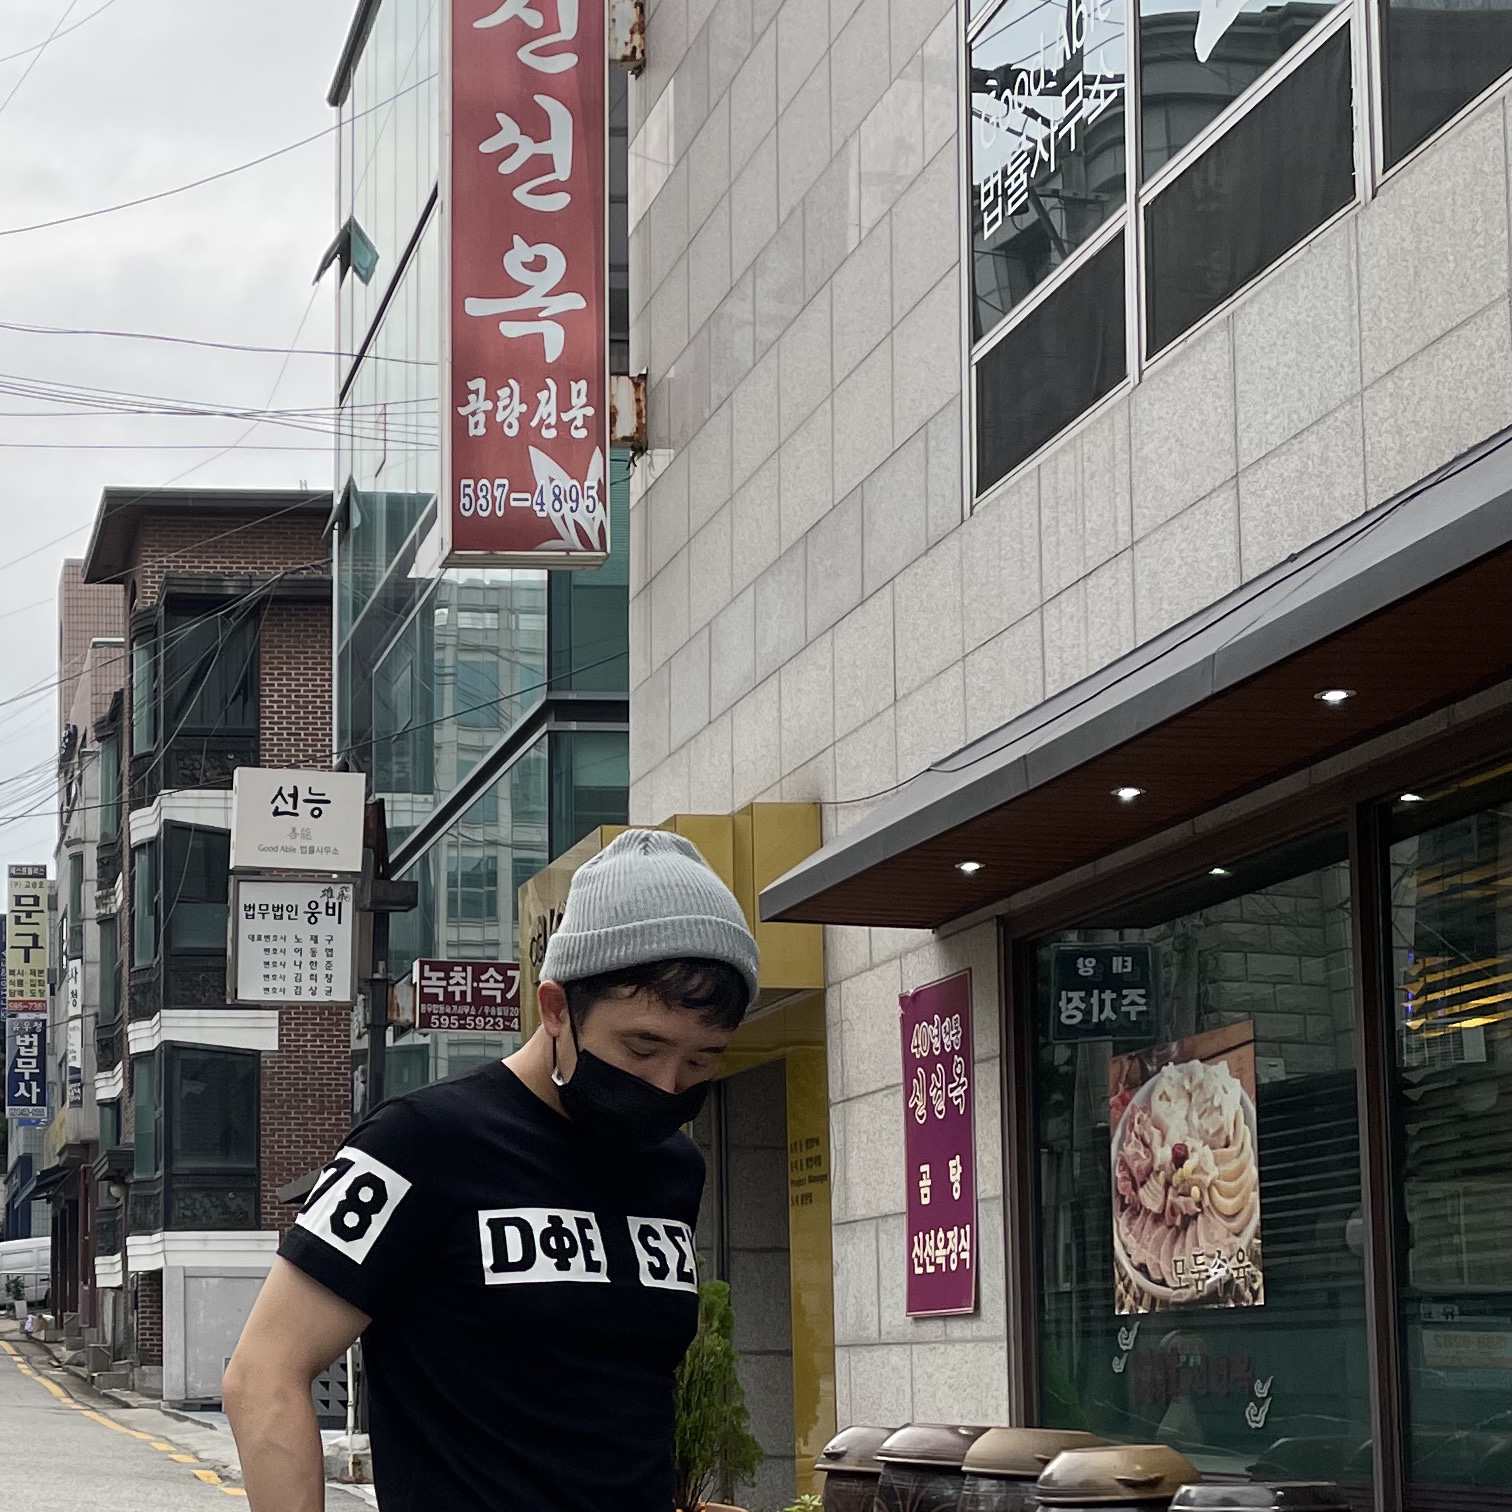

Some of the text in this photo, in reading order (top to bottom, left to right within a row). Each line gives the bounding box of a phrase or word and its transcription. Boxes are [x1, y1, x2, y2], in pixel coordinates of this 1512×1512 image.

[459, 478, 598, 519] 537-4895
[270, 785, 332, 819] 선능
[257, 843, 279, 853] Good
[9, 893, 45, 964] 문구
[243, 899, 343, 925] 법무법인 웅비
[13, 1033, 41, 1105] 법무사
[911, 1223, 970, 1275] 신선옥정식
